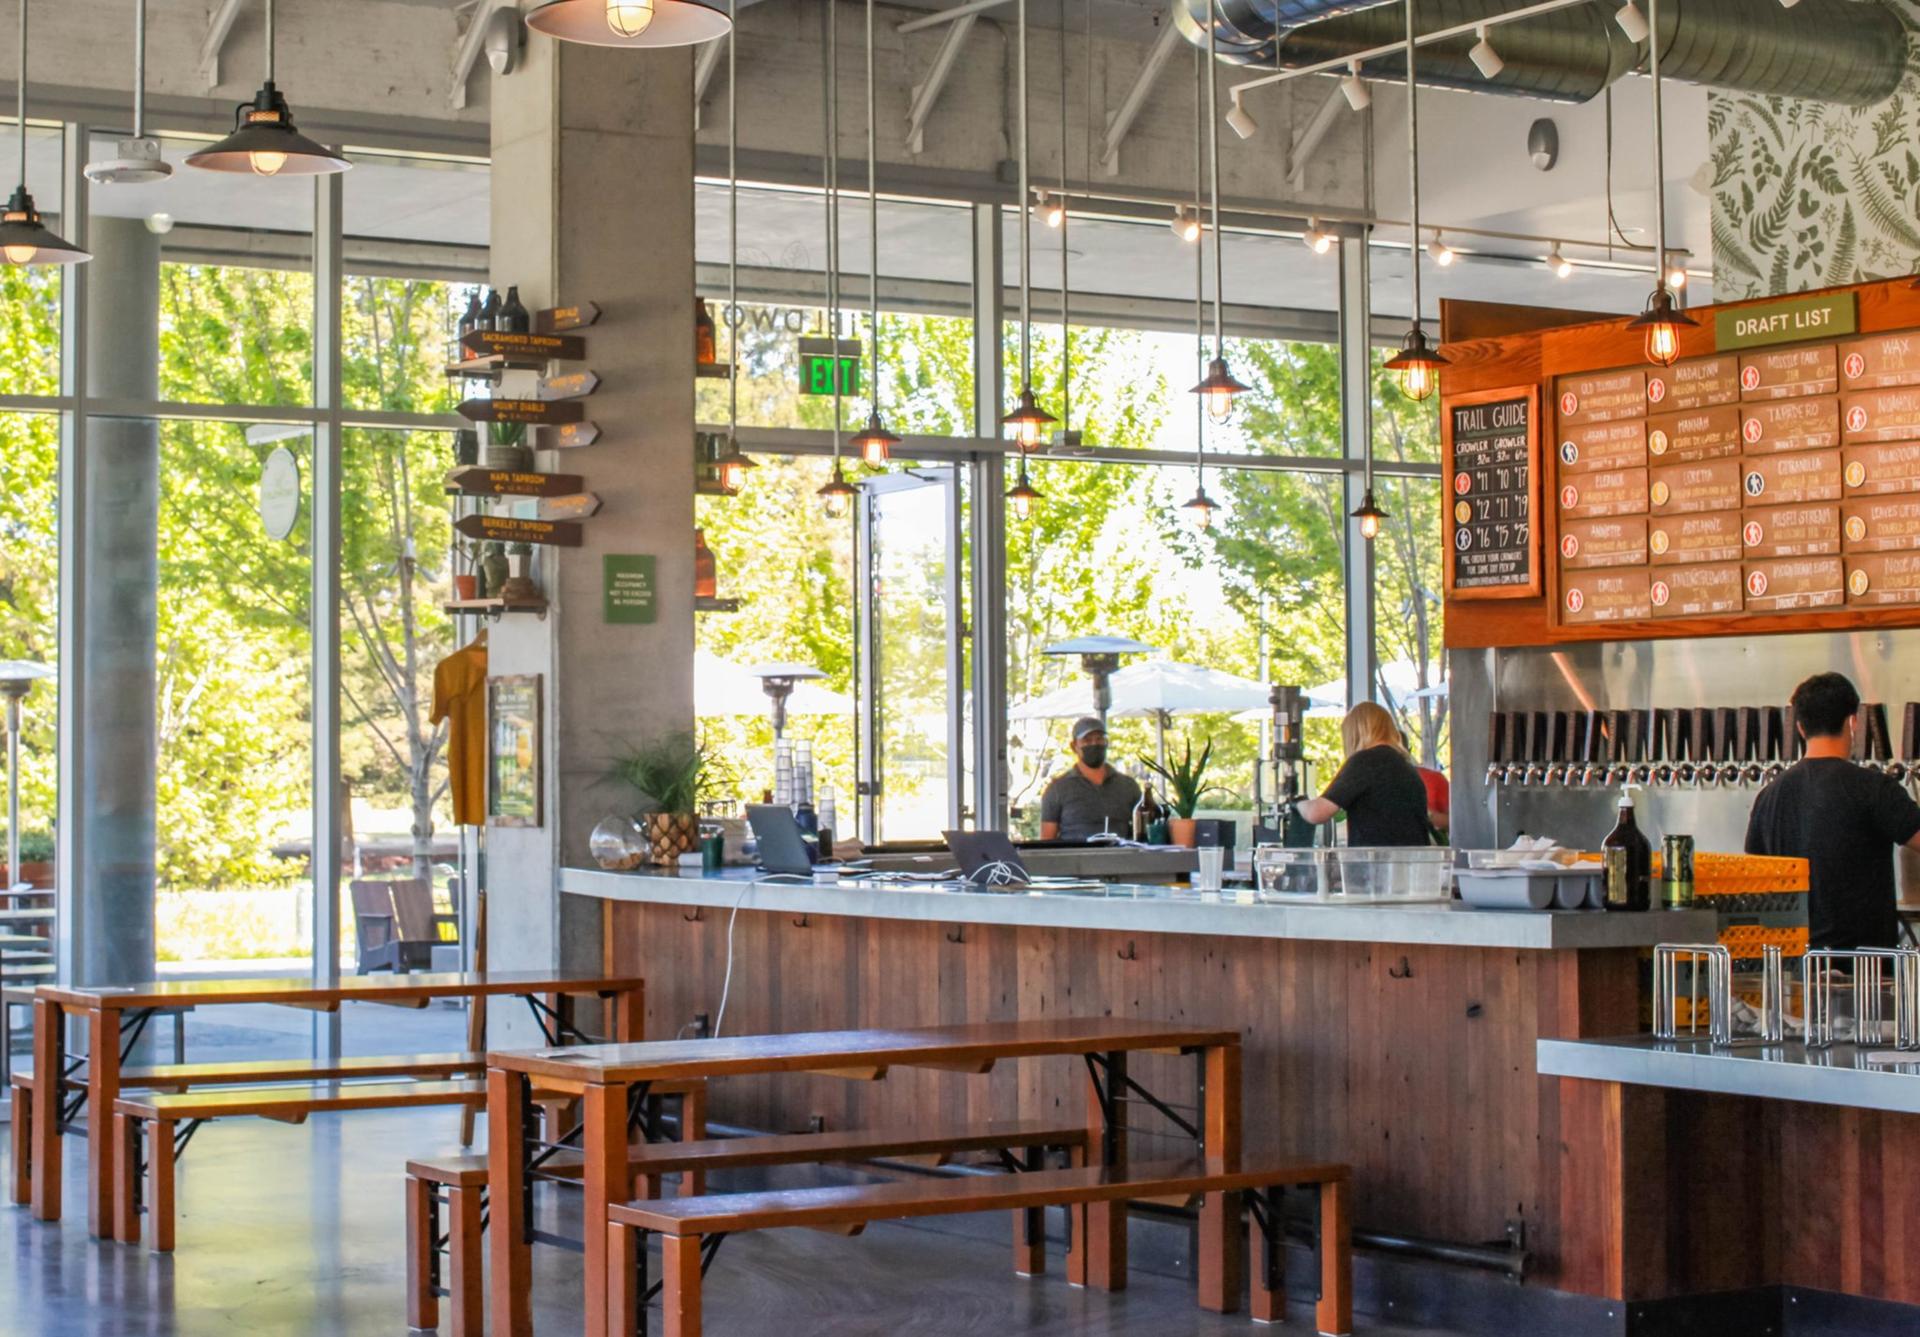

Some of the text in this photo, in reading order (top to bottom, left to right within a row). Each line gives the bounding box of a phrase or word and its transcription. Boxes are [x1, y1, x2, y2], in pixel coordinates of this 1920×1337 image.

[1736, 307, 1832, 337] DRAFT LIST
[481, 332, 562, 346] SACRAMENTO TAPROOM
[811, 357, 853, 396] EXT
[492, 400, 545, 412] MOUNT DIABLO
[1456, 403, 1527, 432] TRAIL GUIDE
[490, 472, 546, 485] NAPA TAPROOM
[1476, 466, 1529, 491] $11 $10 $17
[1476, 495, 1529, 521] $12 $11 $19
[481, 517, 554, 533] BERKELEY TAPROOM
[1476, 527, 1491, 548] $16
[1495, 525, 1510, 547] $15
